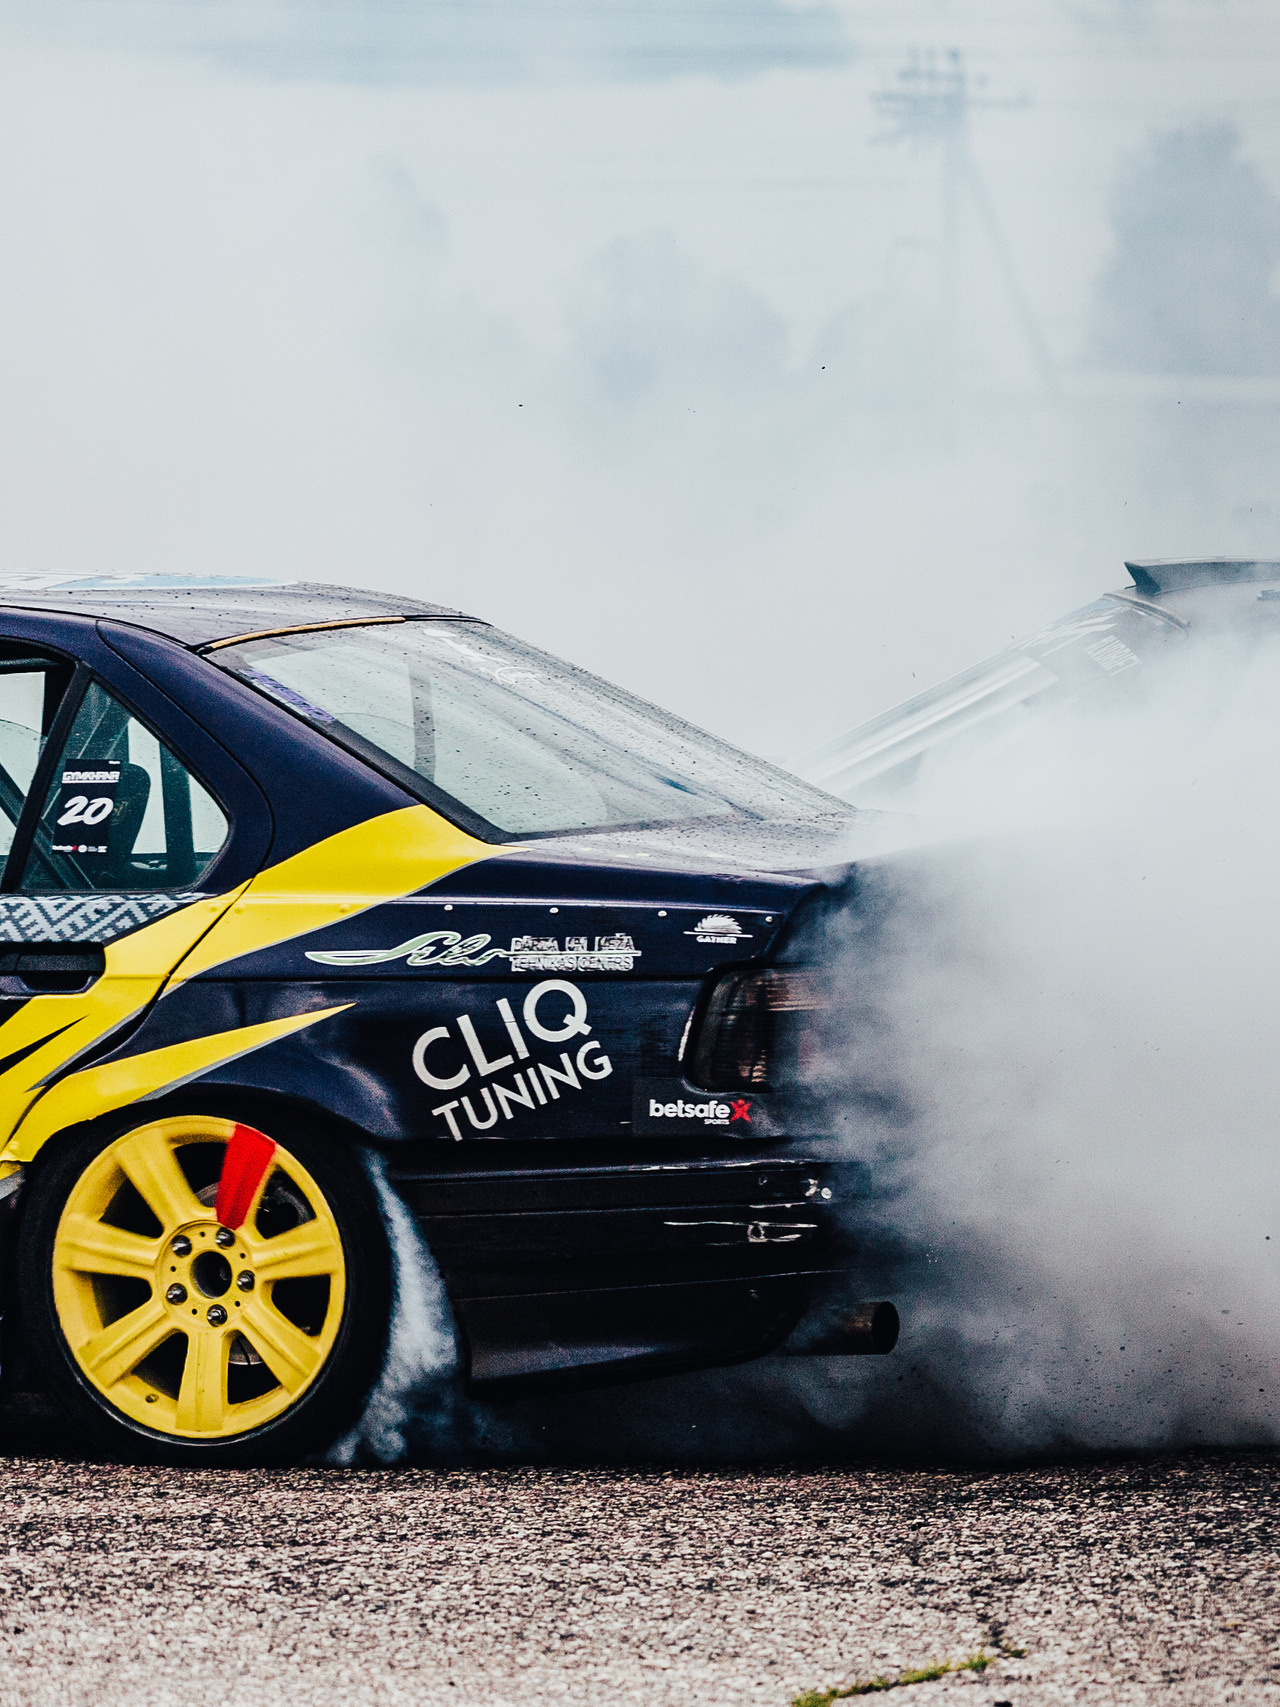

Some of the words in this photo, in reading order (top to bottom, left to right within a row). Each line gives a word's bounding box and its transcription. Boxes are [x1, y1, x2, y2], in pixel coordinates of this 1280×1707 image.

[62, 770, 120, 781] GYMKHANA
[56, 795, 114, 827] 20
[412, 979, 594, 1091] CLIQ
[431, 1040, 615, 1142] TUNING
